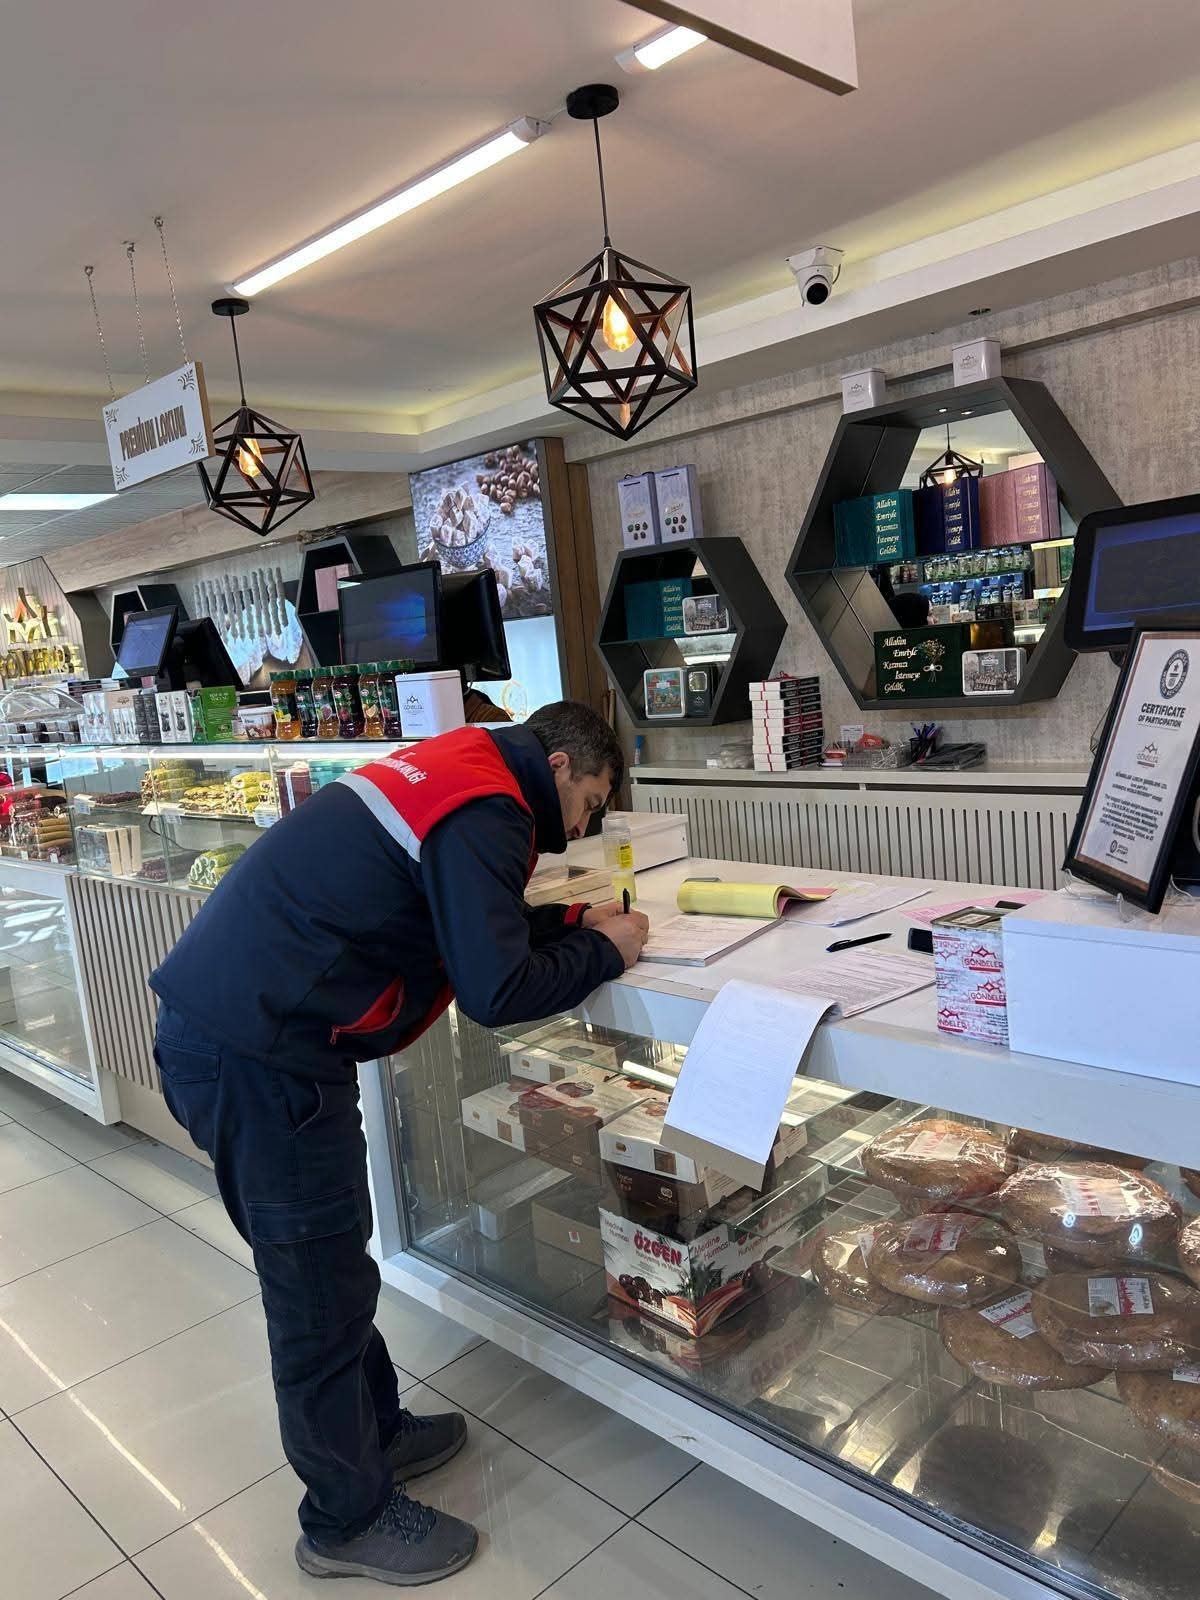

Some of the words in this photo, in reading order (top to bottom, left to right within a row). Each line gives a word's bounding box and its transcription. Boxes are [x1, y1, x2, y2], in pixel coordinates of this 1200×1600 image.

[876, 510, 897, 521] Emriyle
[879, 545, 897, 556] Geldik
[892, 648, 918, 659] Emriyle
[1141, 702, 1186, 718] CERTIFICATE
[1137, 714, 1145, 722] OF
[1145, 716, 1182, 728] PARTICIPATION
[938, 1018, 967, 1030] NDELER
[633, 1228, 683, 1266] ÖZGEN
[694, 1236, 721, 1255] Medine
